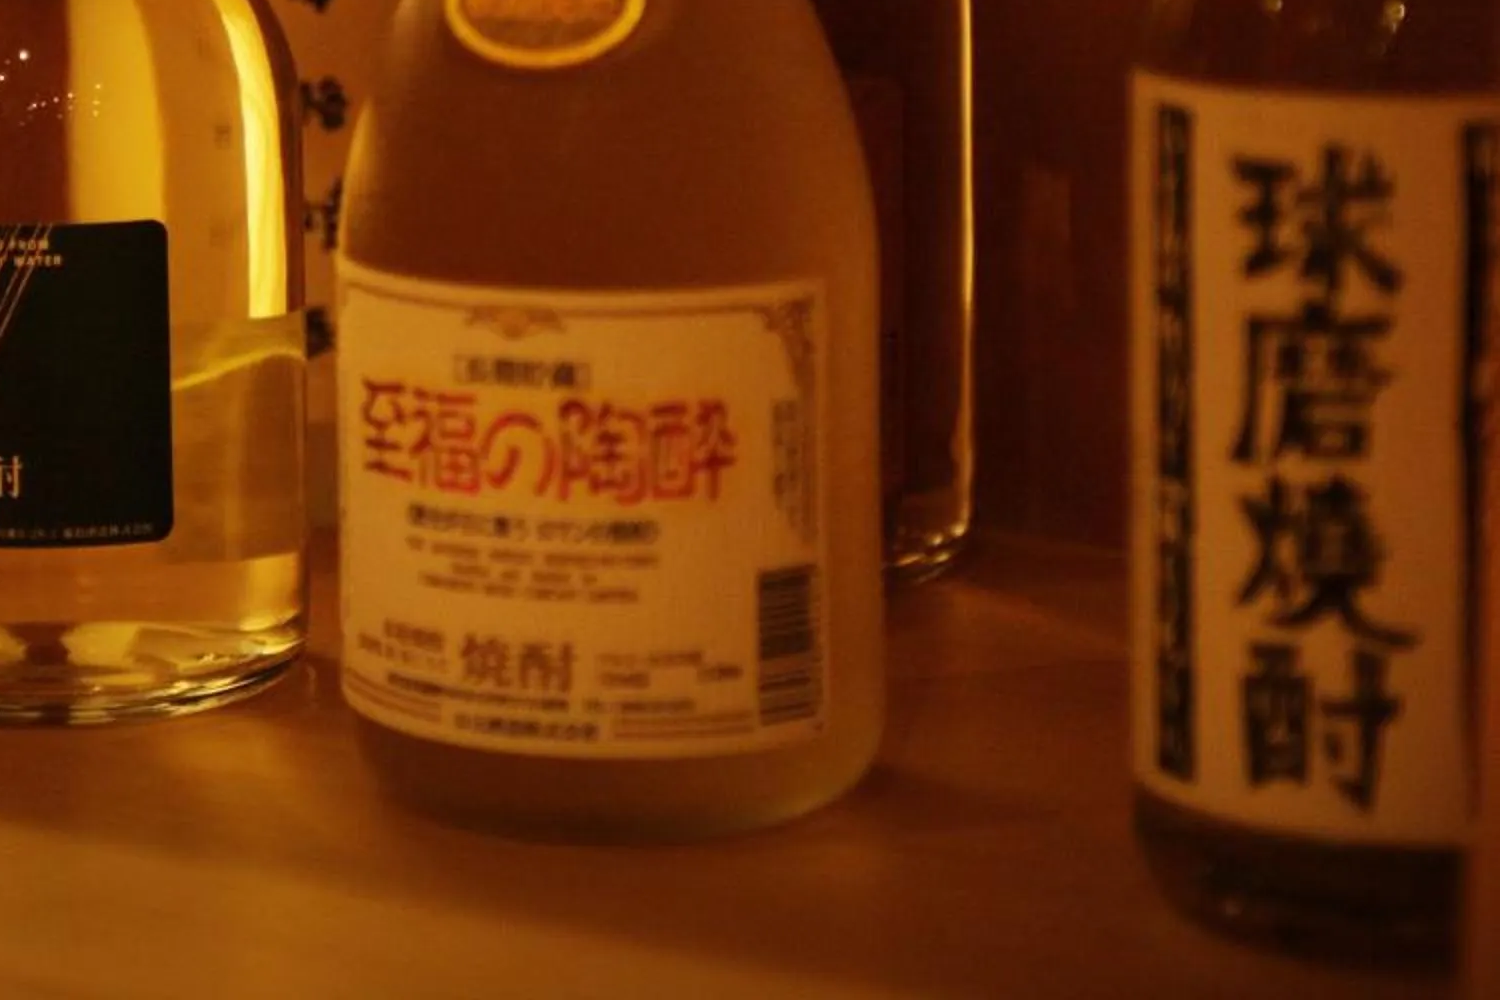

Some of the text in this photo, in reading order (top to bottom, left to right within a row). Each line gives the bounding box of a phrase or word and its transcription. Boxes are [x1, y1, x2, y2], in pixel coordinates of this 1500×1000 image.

[9, 236, 49, 250] FROM
[14, 254, 62, 267] WATER
[361, 376, 738, 505] 至福の陶酔
[461, 632, 575, 693] 焼酎
